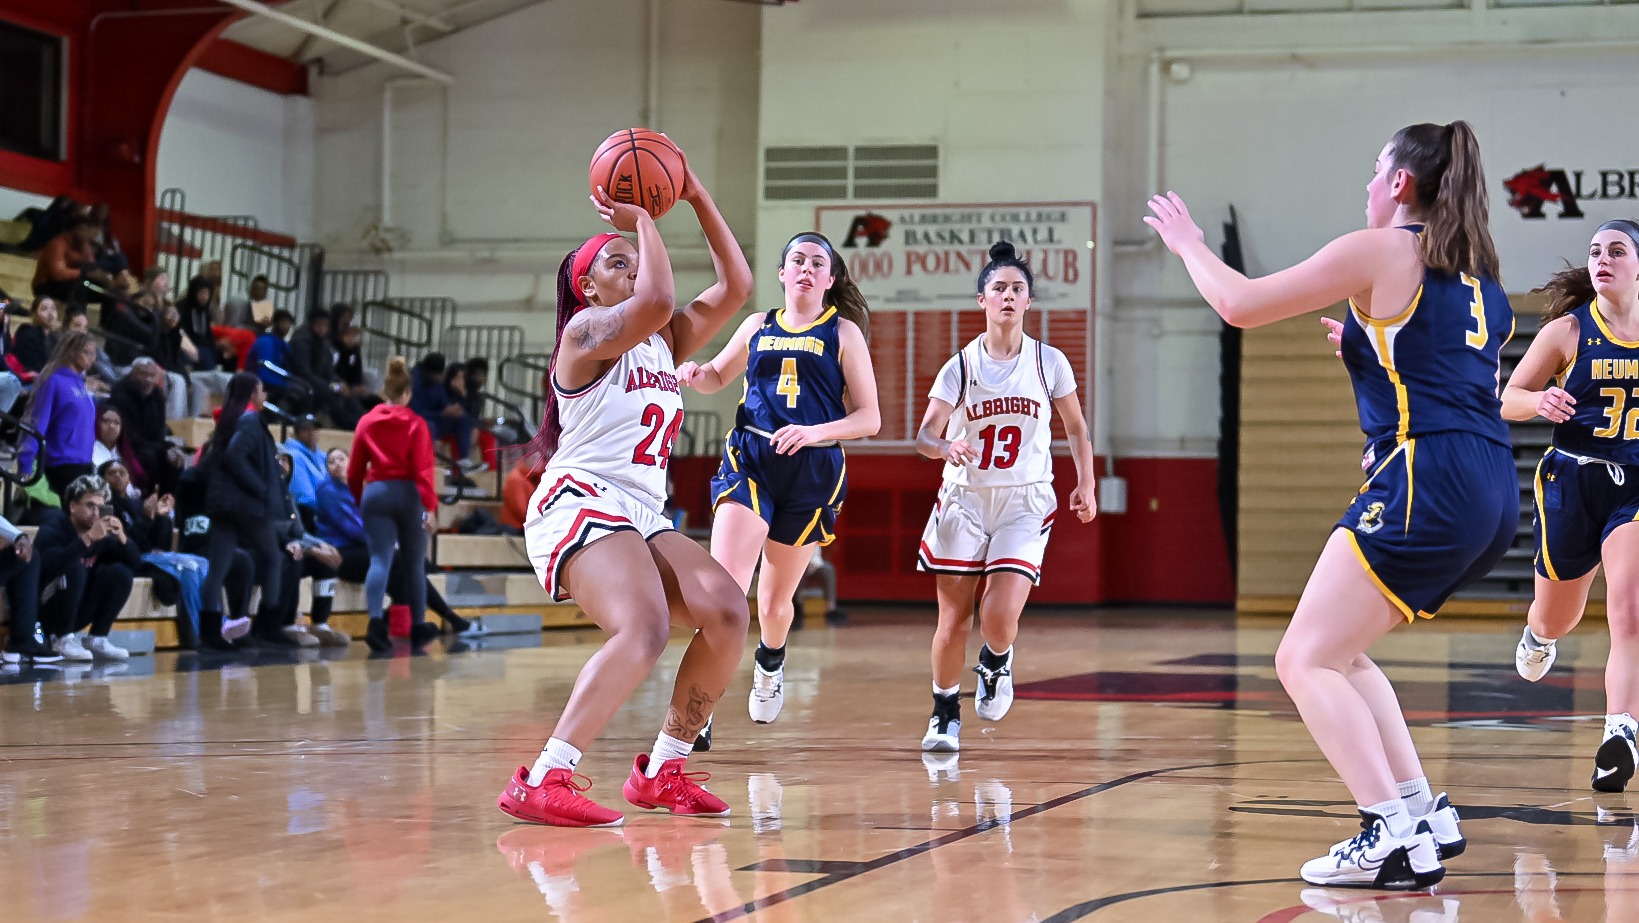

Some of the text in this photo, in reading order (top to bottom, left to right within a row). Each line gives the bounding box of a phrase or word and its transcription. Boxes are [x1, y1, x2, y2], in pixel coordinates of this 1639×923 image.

[899, 209, 1069, 225] ALBRIGHT COLLEGE
[904, 226, 1062, 246] BASKETBALL
[849, 251, 894, 282] 000
[1024, 248, 1080, 284] LUB
[1460, 272, 1488, 350] 3
[756, 335, 825, 357] NEUMANN
[776, 357, 801, 408] 4
[965, 396, 1041, 422] ALBRIGHT
[631, 402, 684, 470] 24
[978, 424, 1022, 471] 13
